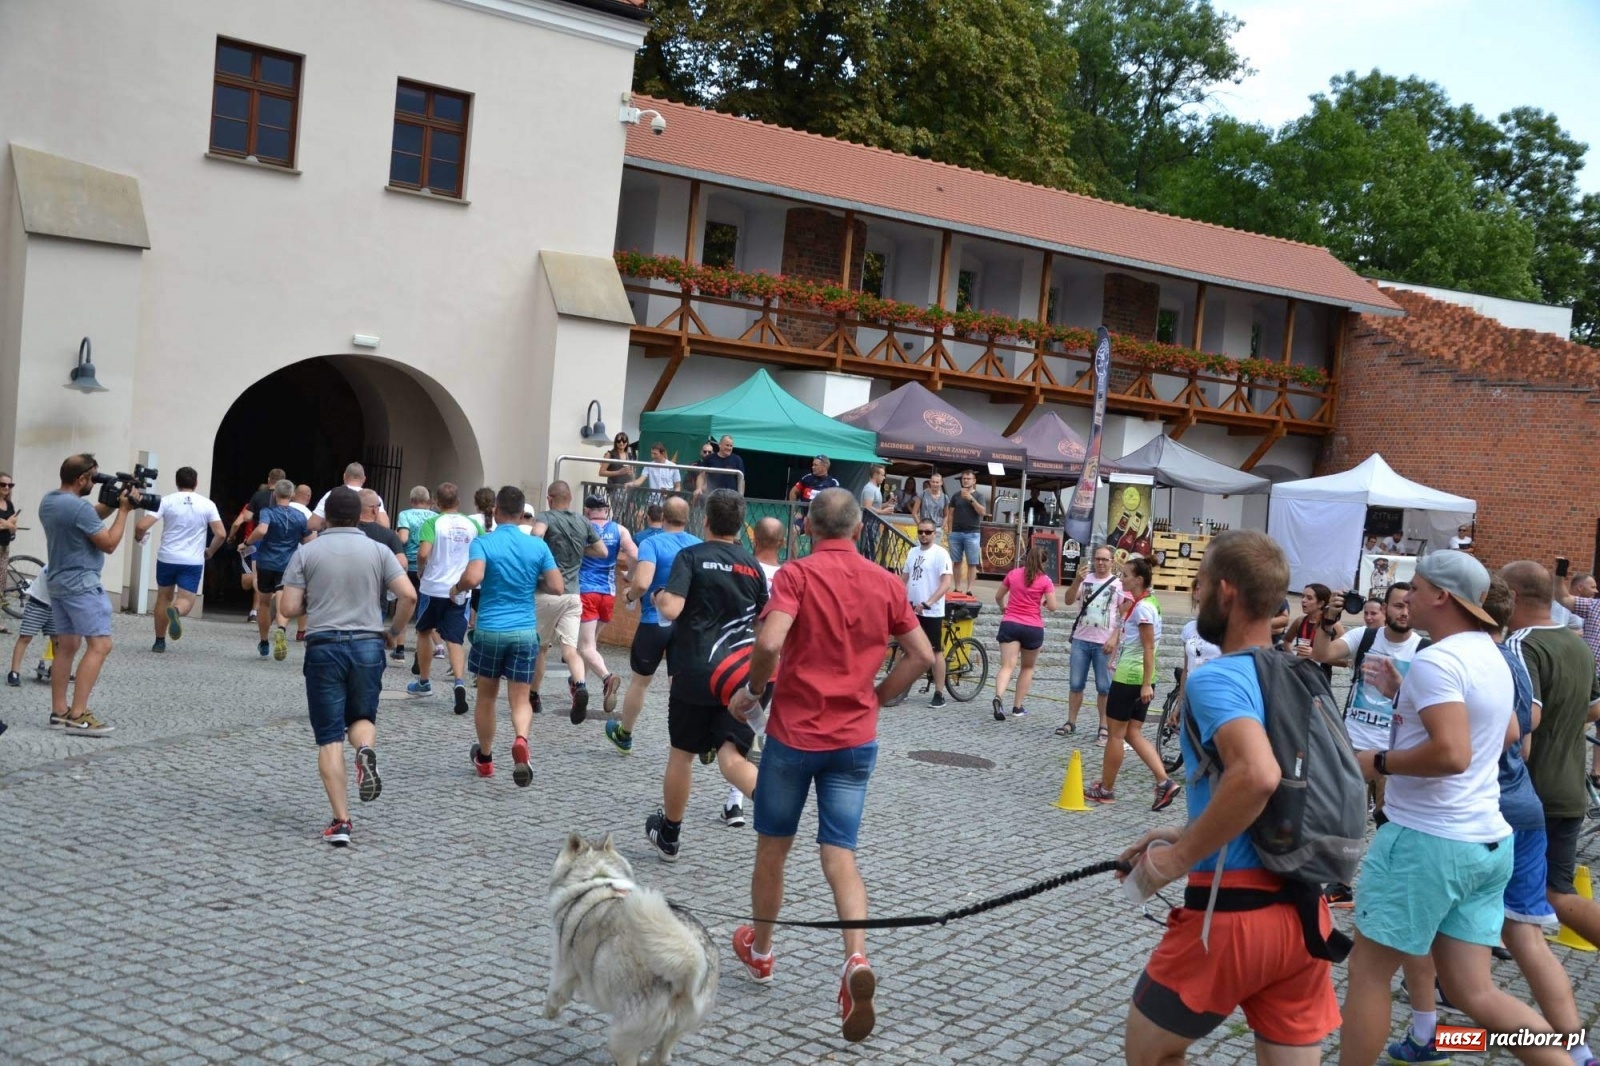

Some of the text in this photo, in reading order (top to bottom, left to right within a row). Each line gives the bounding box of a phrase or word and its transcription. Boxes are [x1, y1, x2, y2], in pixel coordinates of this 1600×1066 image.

[880, 441, 914, 451] RACIBORSKIE
[926, 444, 951, 453] BROWAR
[951, 447, 982, 457] ZAMKOWY
[991, 452, 1023, 461] RACIBORSKIE
